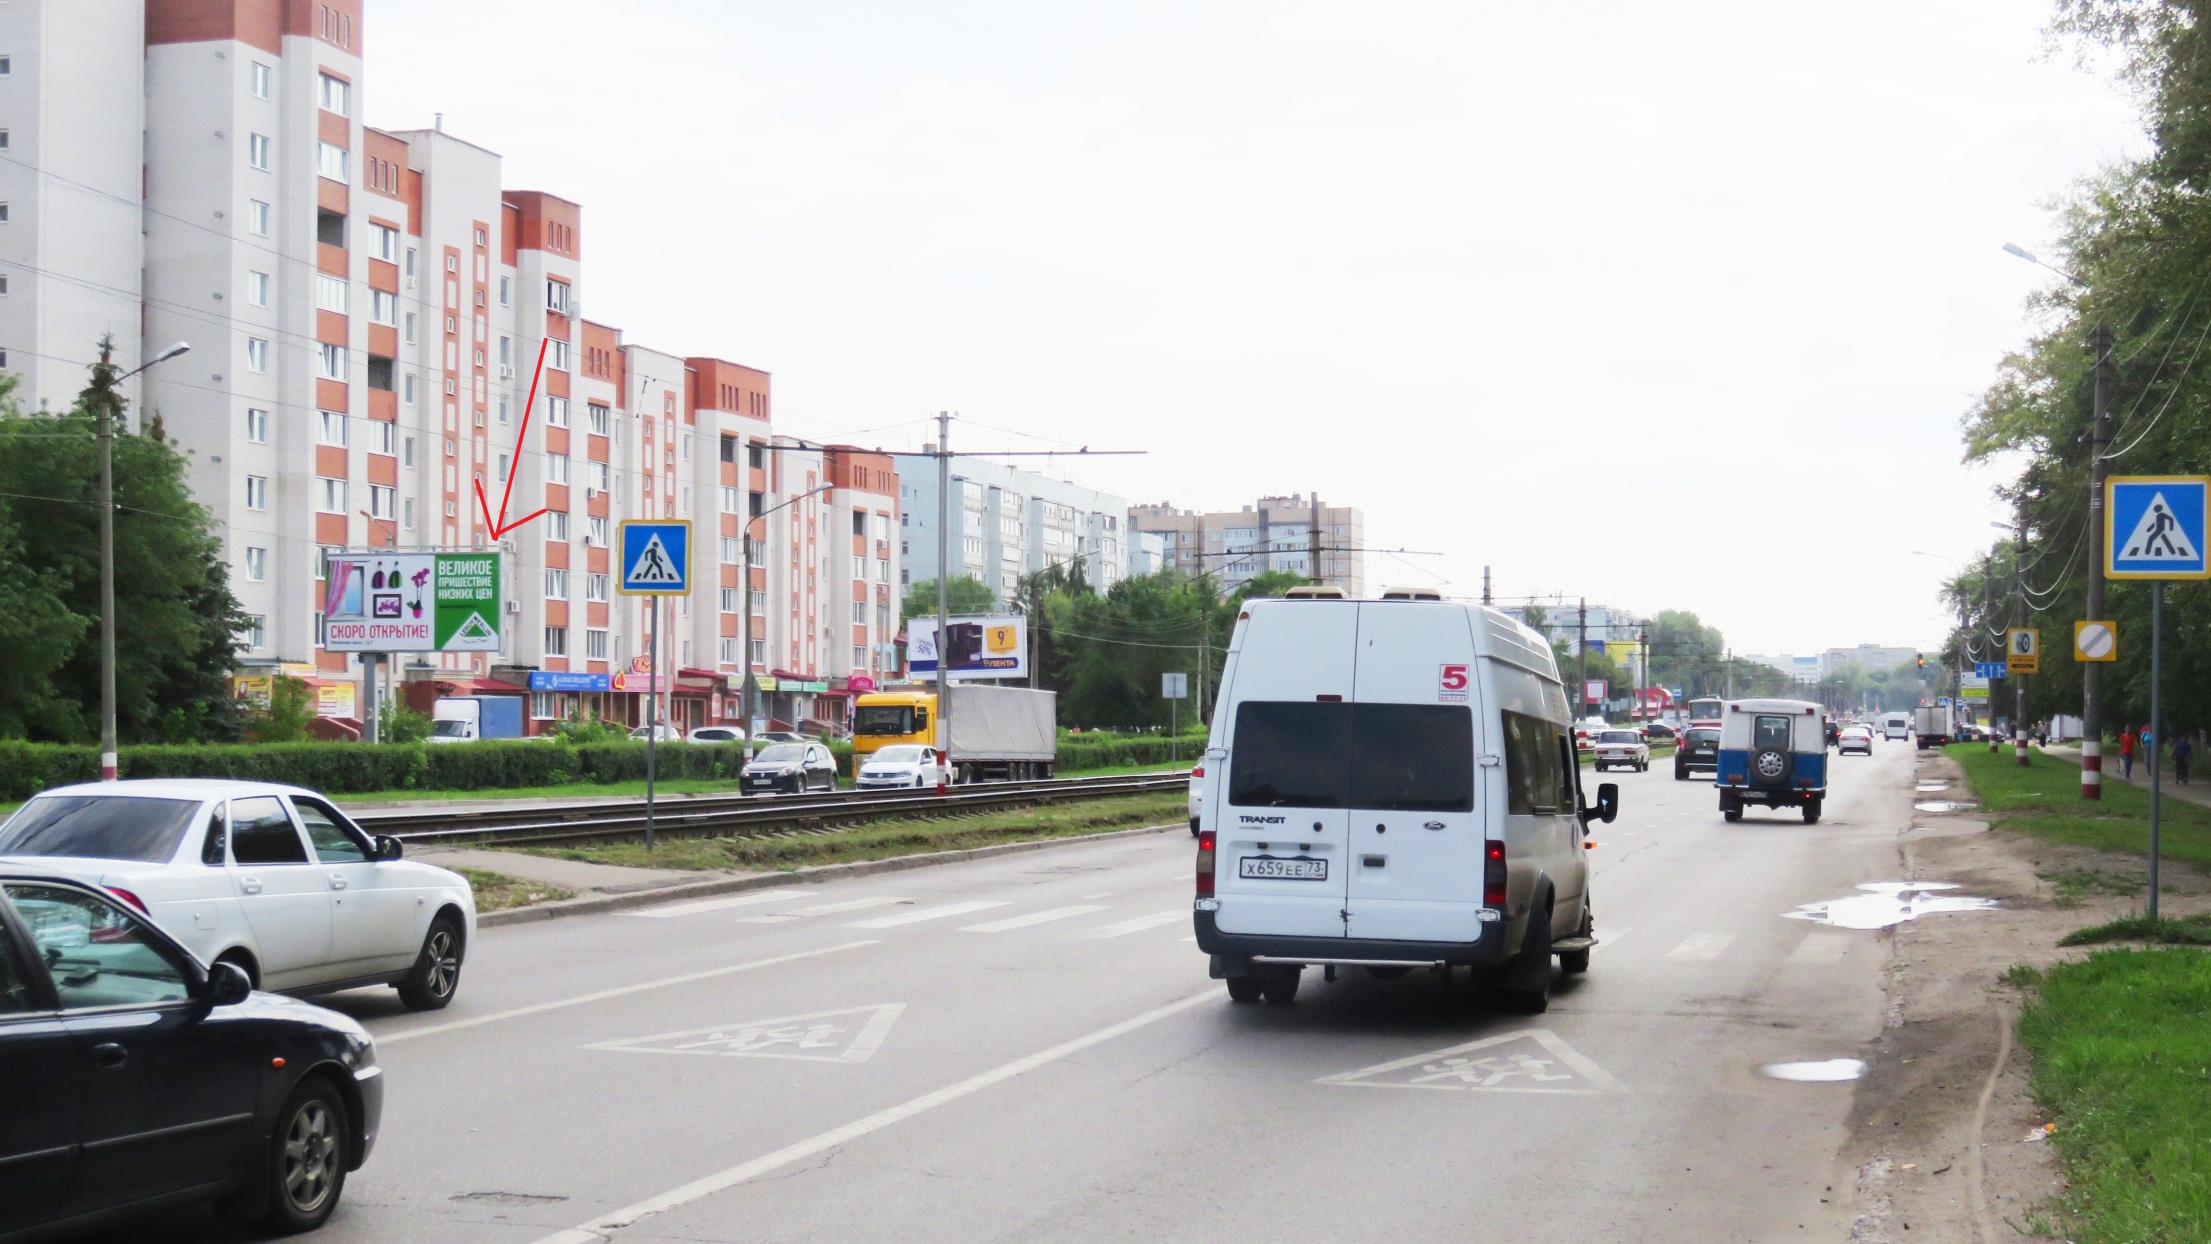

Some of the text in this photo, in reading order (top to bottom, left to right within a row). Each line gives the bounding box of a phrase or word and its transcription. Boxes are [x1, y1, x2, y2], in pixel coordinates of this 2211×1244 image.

[438, 560, 493, 576] ВЕЛИКОЕ
[438, 576, 493, 587] ПРИШЕСТВИЕ
[438, 588, 493, 600] НИЗКИХ ЦЕН
[330, 624, 429, 639] СКОРО ОТКРЫТИЕ!
[1441, 666, 1468, 690] 5
[1239, 815, 1286, 824] TRANSIT
